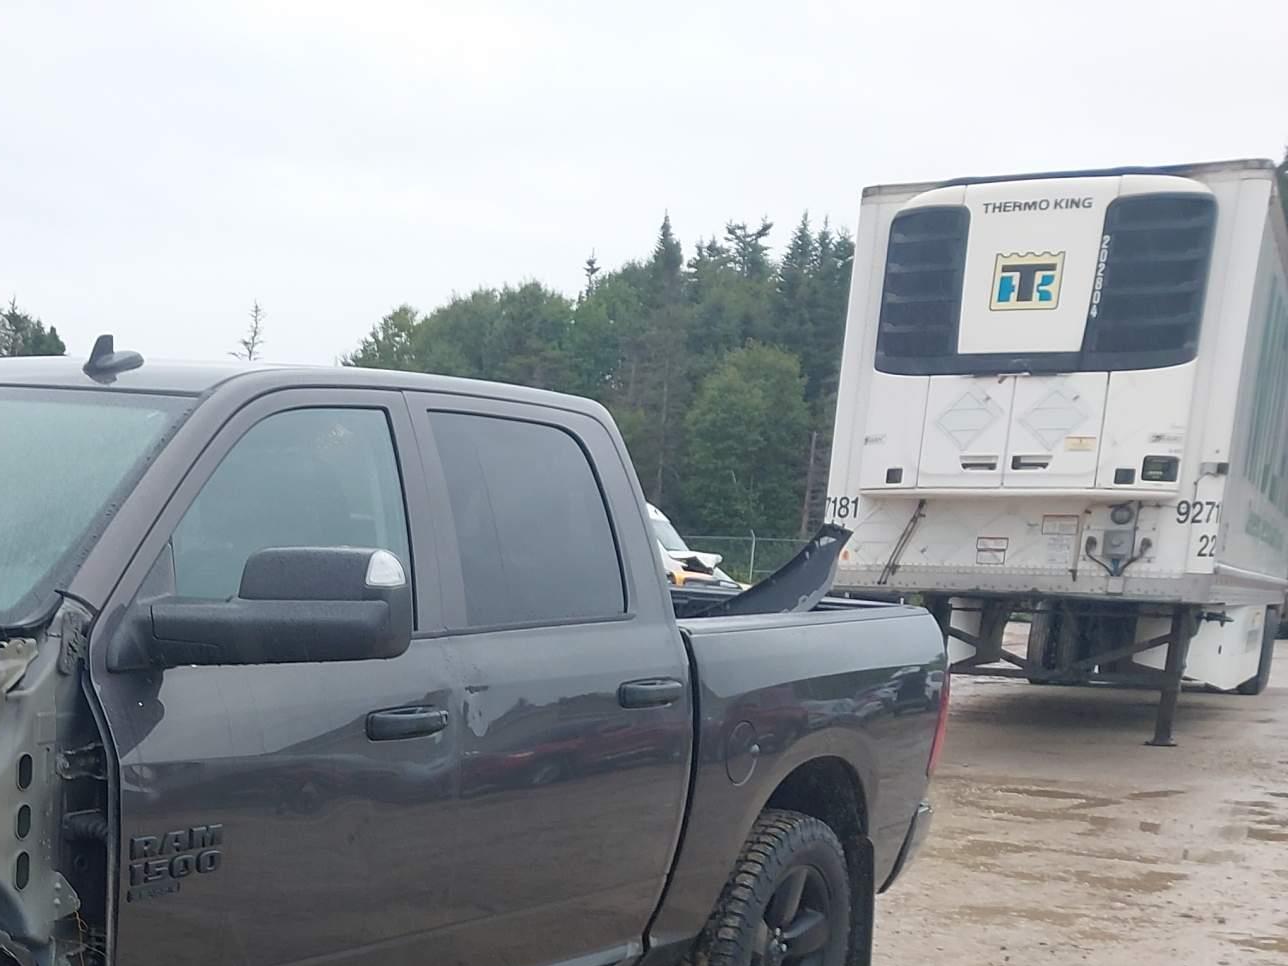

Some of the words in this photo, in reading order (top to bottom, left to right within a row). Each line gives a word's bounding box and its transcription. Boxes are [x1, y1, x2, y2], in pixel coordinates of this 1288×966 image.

[983, 199, 1050, 214] THERMO
[1053, 197, 1093, 210] KING
[1176, 500, 1220, 524] 9271
[129, 823, 223, 862] RAM
[129, 849, 224, 887] 1500
